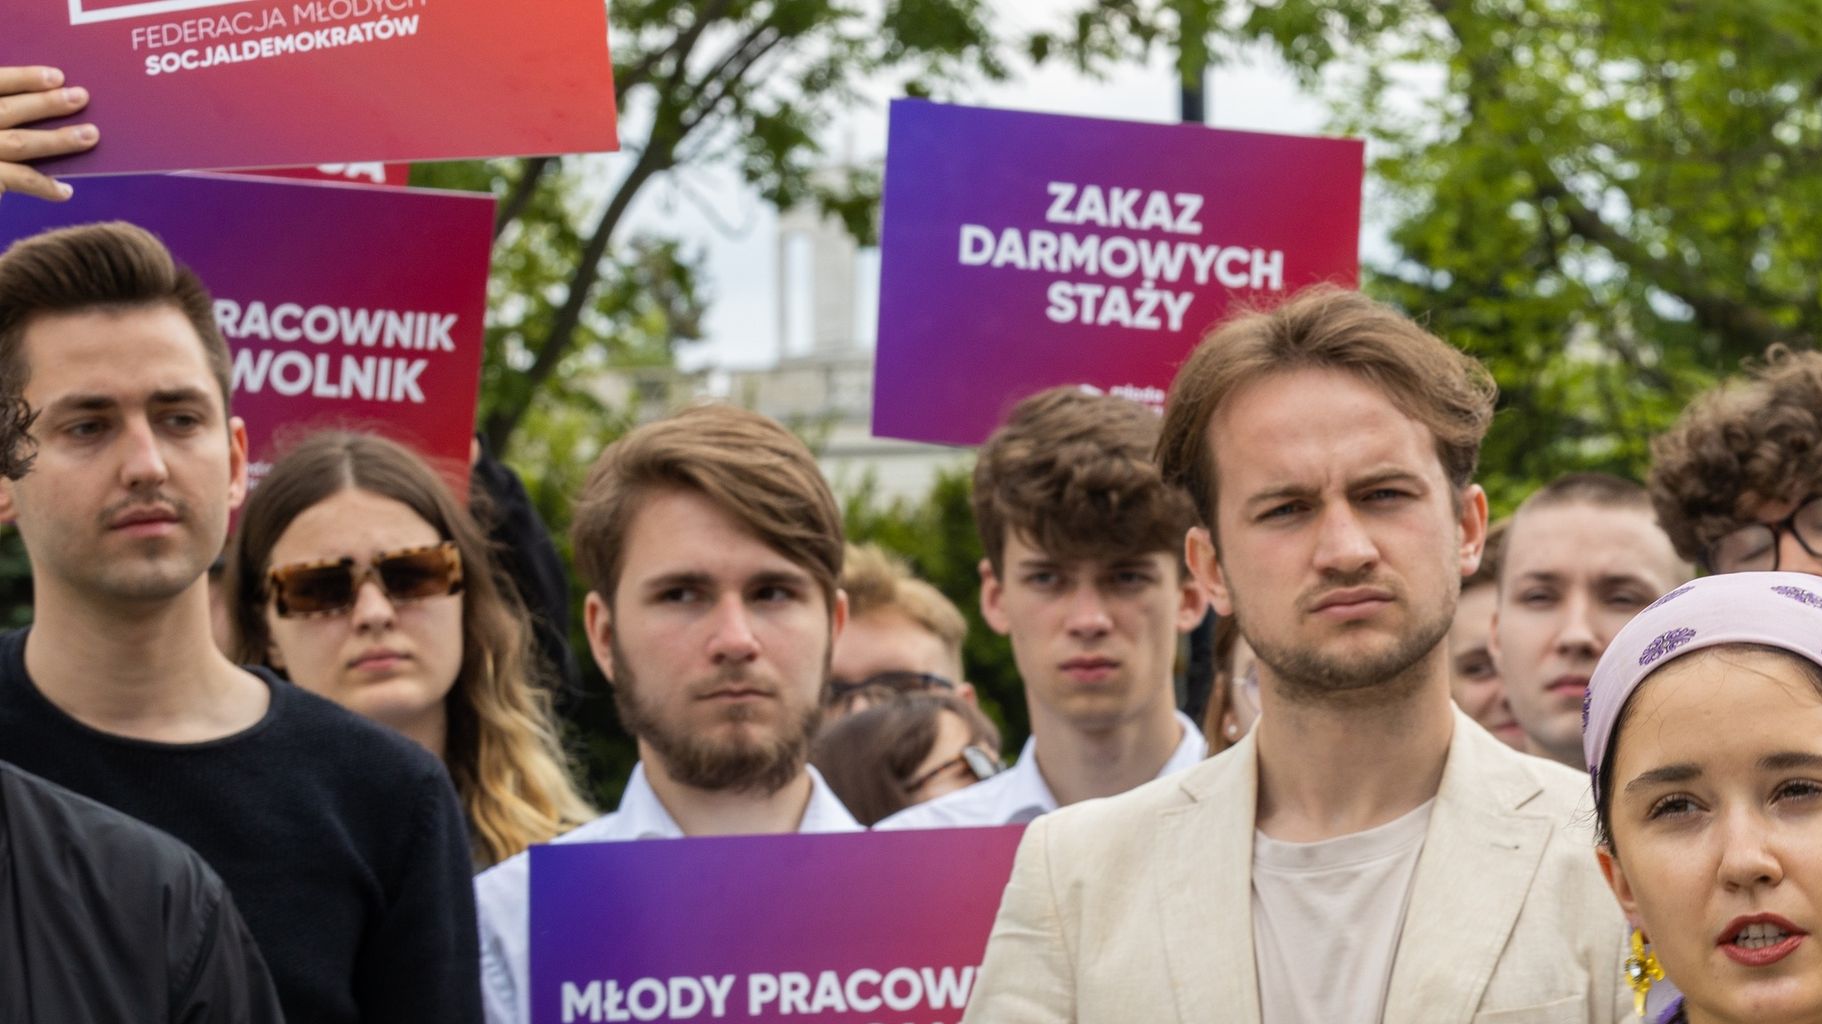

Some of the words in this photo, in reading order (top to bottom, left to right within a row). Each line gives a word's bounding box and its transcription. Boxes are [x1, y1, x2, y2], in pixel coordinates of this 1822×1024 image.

[131, 6, 287, 50] FEDERACJA
[144, 14, 420, 76] SOCJALDEMOKRATÓW
[1045, 182, 1204, 236] ZAKAZ
[958, 225, 1284, 291] DARMOWYCH
[1045, 280, 1194, 333] STAŻY
[561, 974, 735, 1023] MŁODY
[748, 965, 981, 1015] PRACOW
